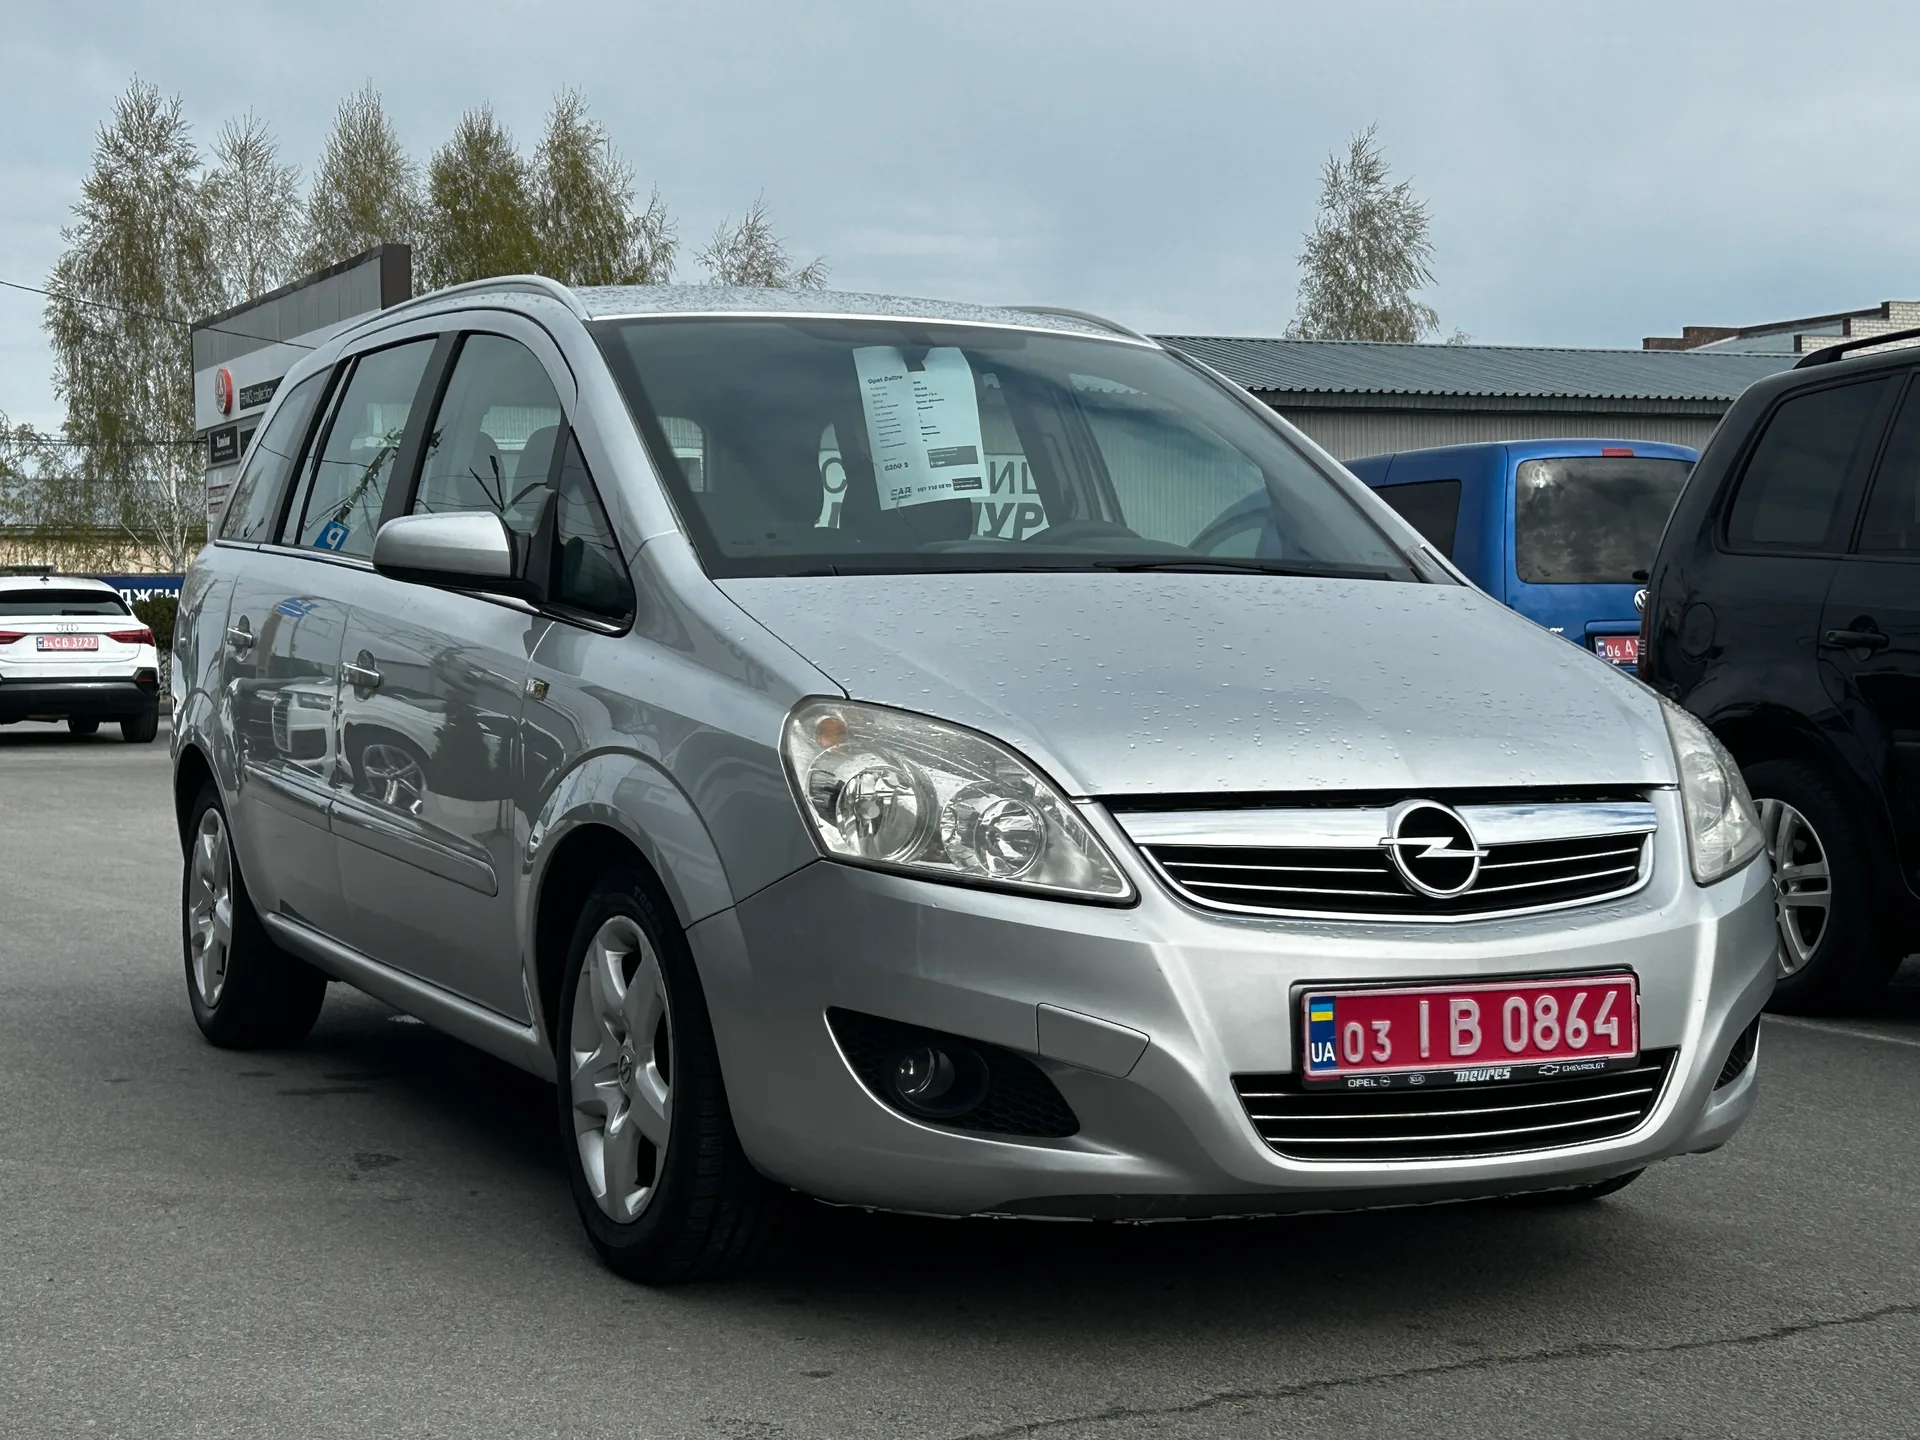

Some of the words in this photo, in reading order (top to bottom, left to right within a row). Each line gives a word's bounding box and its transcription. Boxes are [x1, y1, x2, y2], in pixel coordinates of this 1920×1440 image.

[1606, 645, 1621, 657] 06
[1311, 1041, 1336, 1063] UA
[1343, 1020, 1392, 1064] 03
[1502, 991, 1619, 1054] 0864
[1347, 1078, 1378, 1088] OPEL
[1562, 1062, 1605, 1072] CHEVROLET
